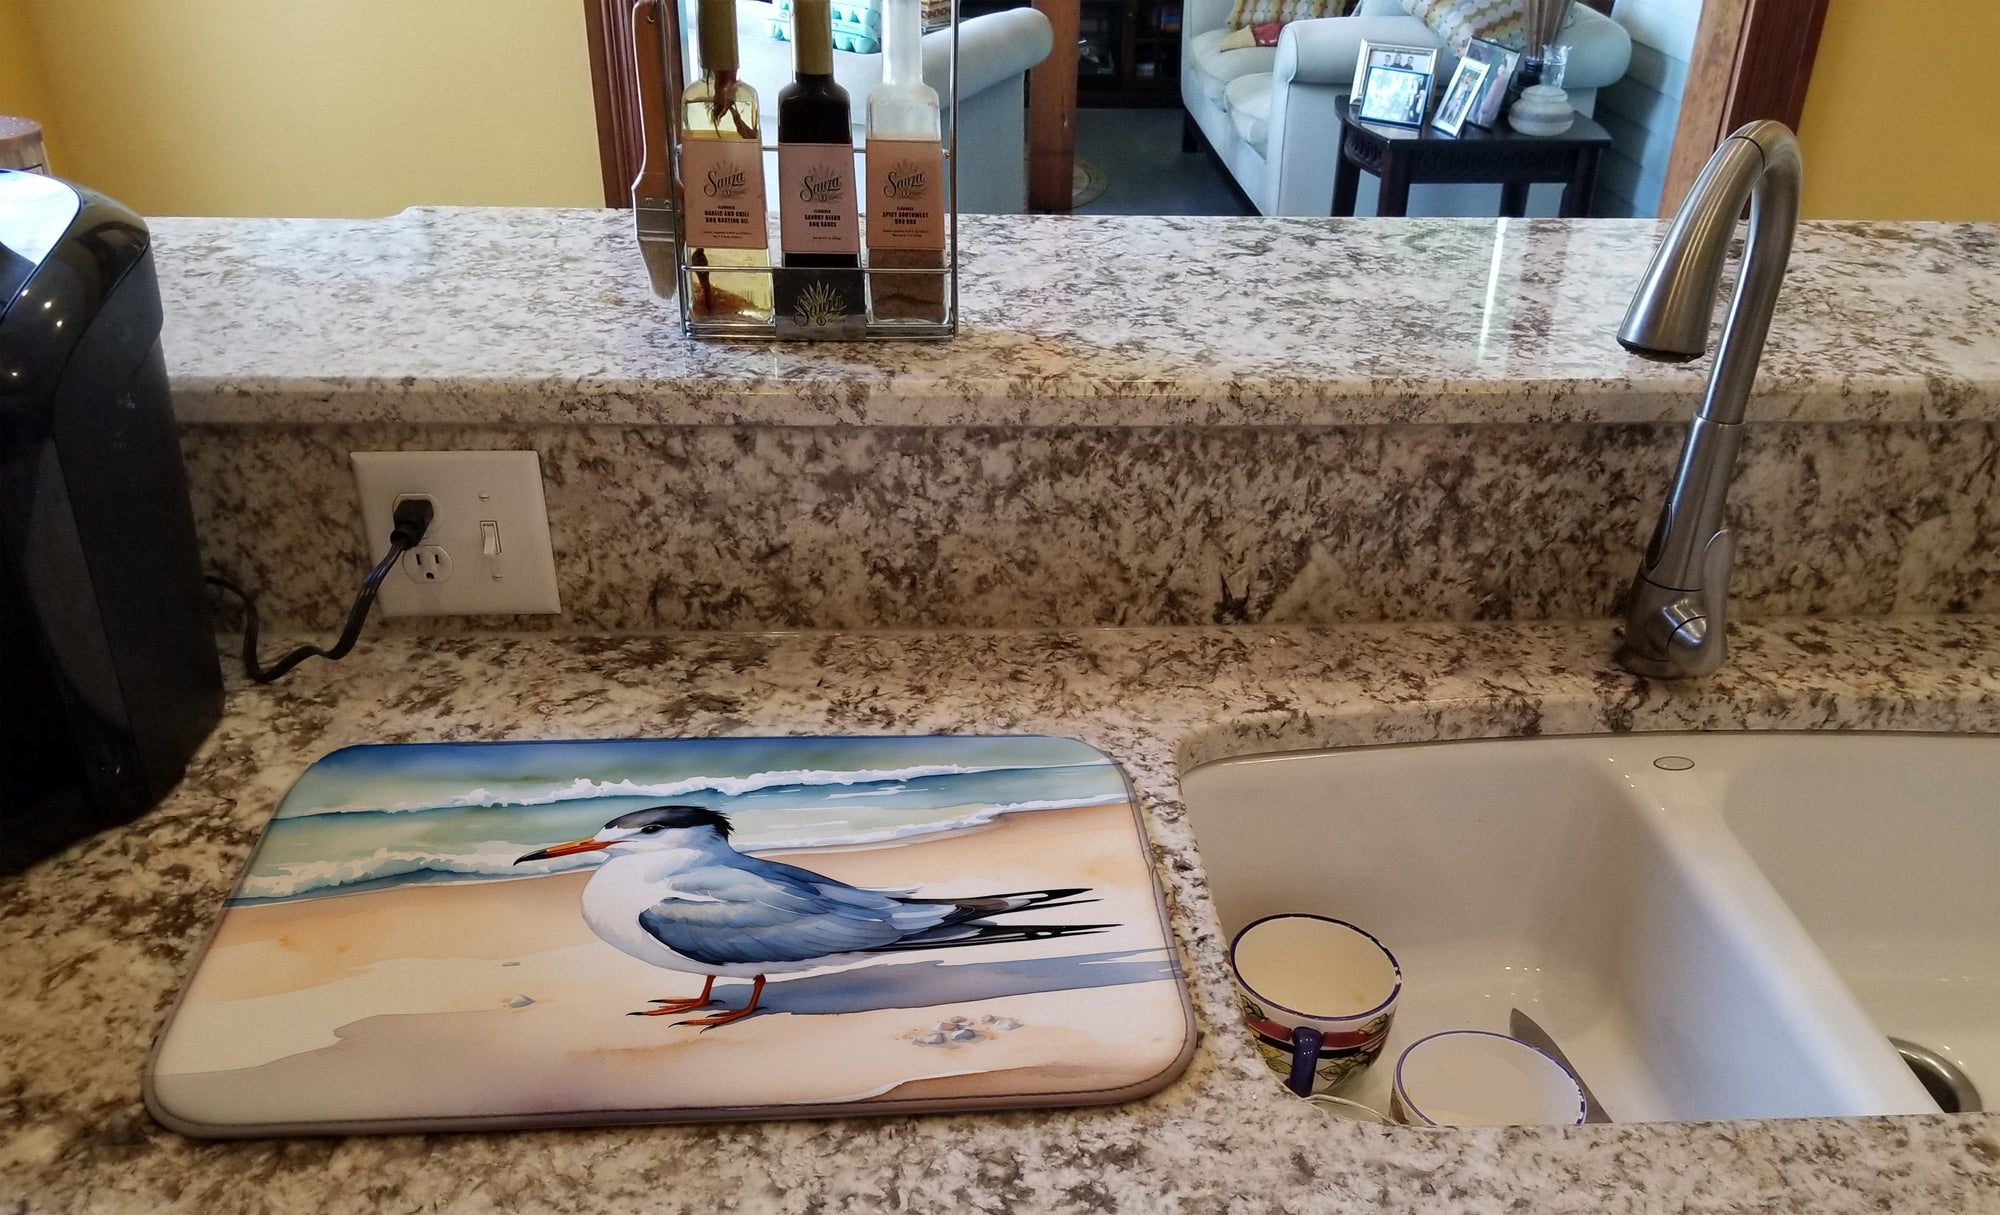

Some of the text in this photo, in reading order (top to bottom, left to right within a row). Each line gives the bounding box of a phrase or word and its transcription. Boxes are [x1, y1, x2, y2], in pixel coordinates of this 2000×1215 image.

[704, 170, 746, 198] Sauza
[800, 175, 842, 202] Sauza
[884, 171, 926, 199] Sauza
[793, 295, 847, 327] Sauza
